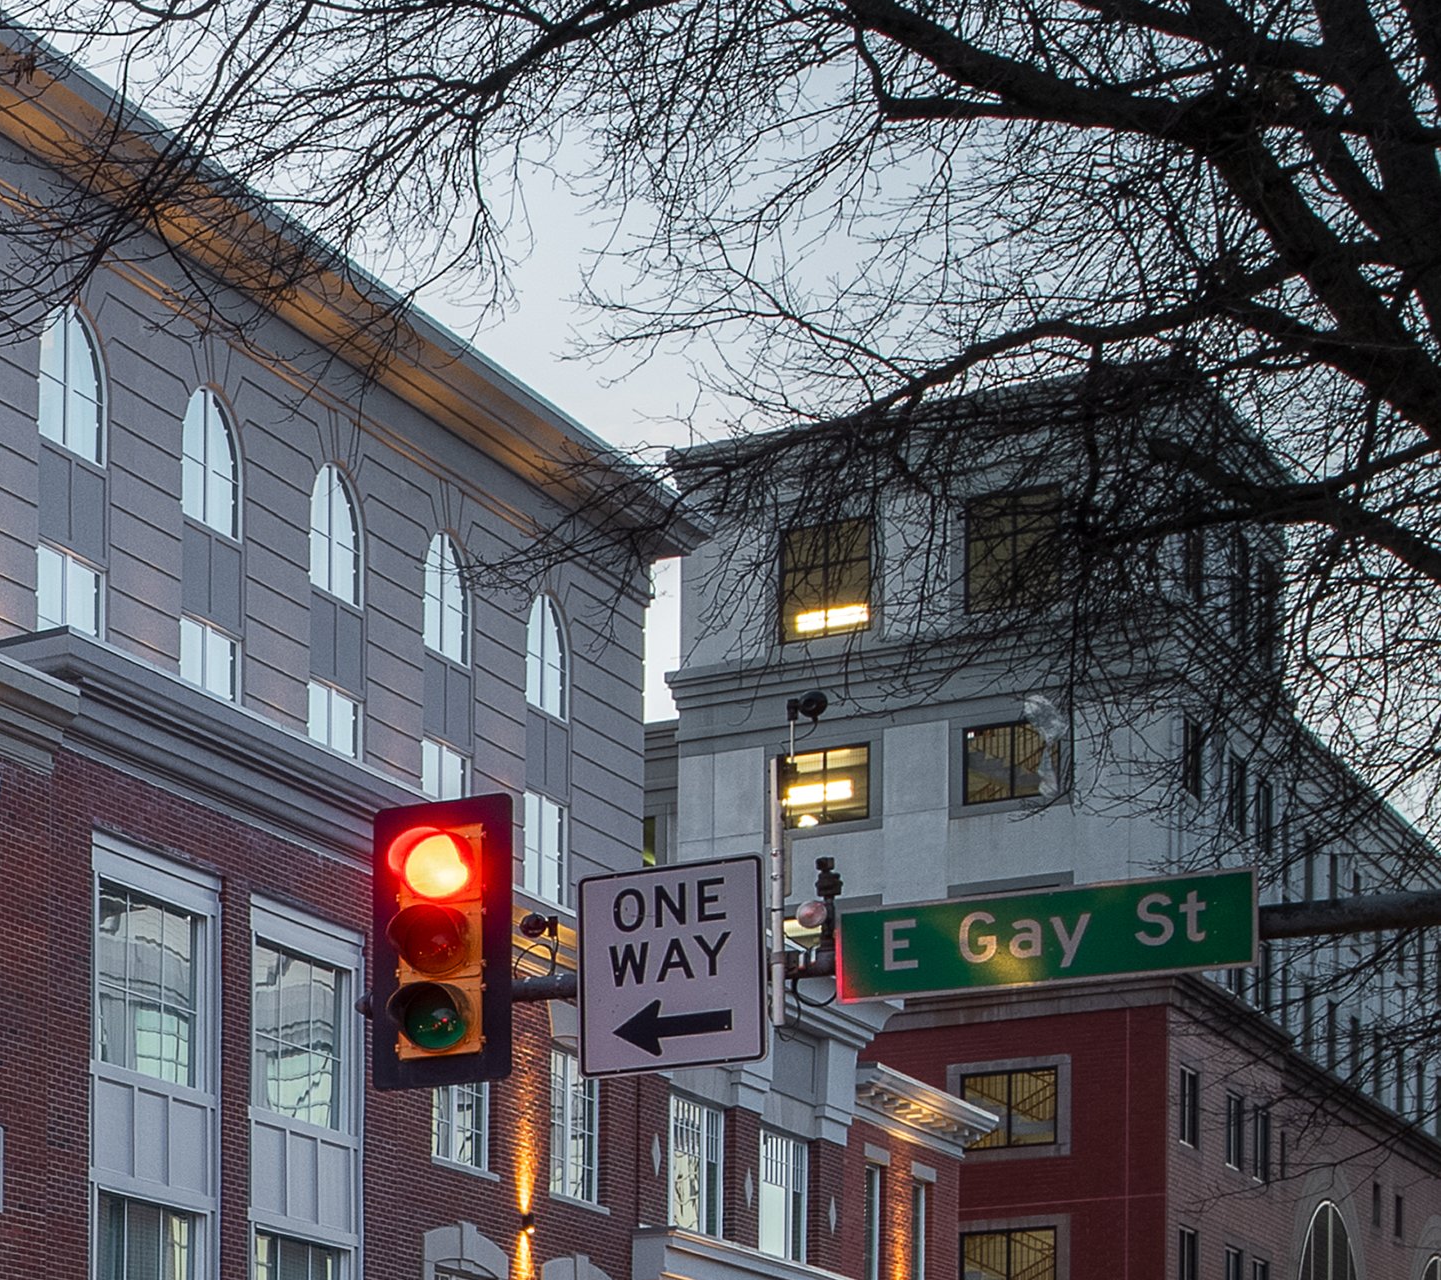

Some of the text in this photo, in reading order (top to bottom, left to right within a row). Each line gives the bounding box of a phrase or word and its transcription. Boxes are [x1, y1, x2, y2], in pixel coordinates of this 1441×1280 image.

[613, 877, 727, 933] ONE
[883, 889, 1207, 972] E Gay St
[608, 931, 732, 988] WAY
